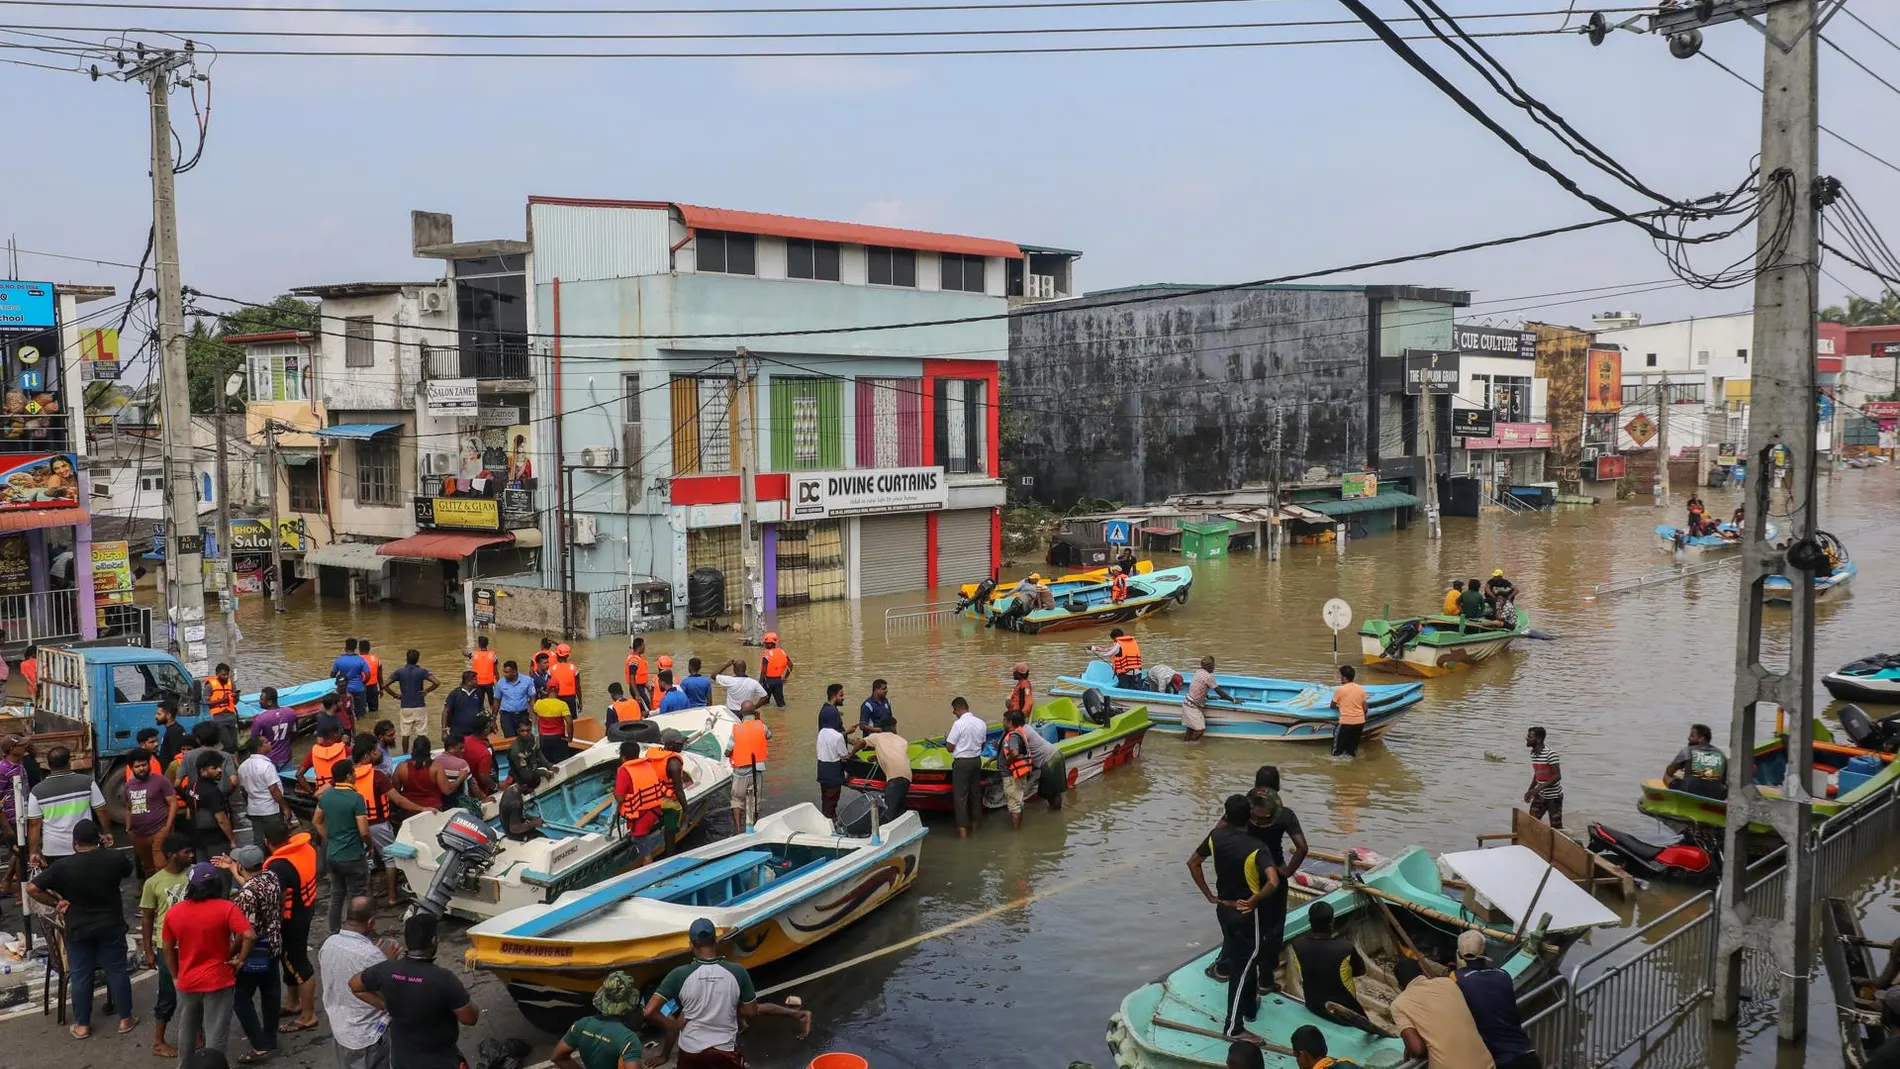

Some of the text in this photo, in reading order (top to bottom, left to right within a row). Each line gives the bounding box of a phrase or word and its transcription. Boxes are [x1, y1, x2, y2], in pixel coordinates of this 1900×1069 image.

[1461, 332, 1479, 349] CUE
[1481, 334, 1518, 352] CULTURE
[1409, 370, 1420, 382] THE
[432, 386, 476, 398] SALON ZAMEE
[490, 409, 516, 417] Zamee
[829, 472, 937, 496] DIVINE CURTAINS
[799, 482, 820, 503] DC
[439, 501, 496, 512] GLITZ & GLAM
[457, 817, 479, 832] YAMAHA
